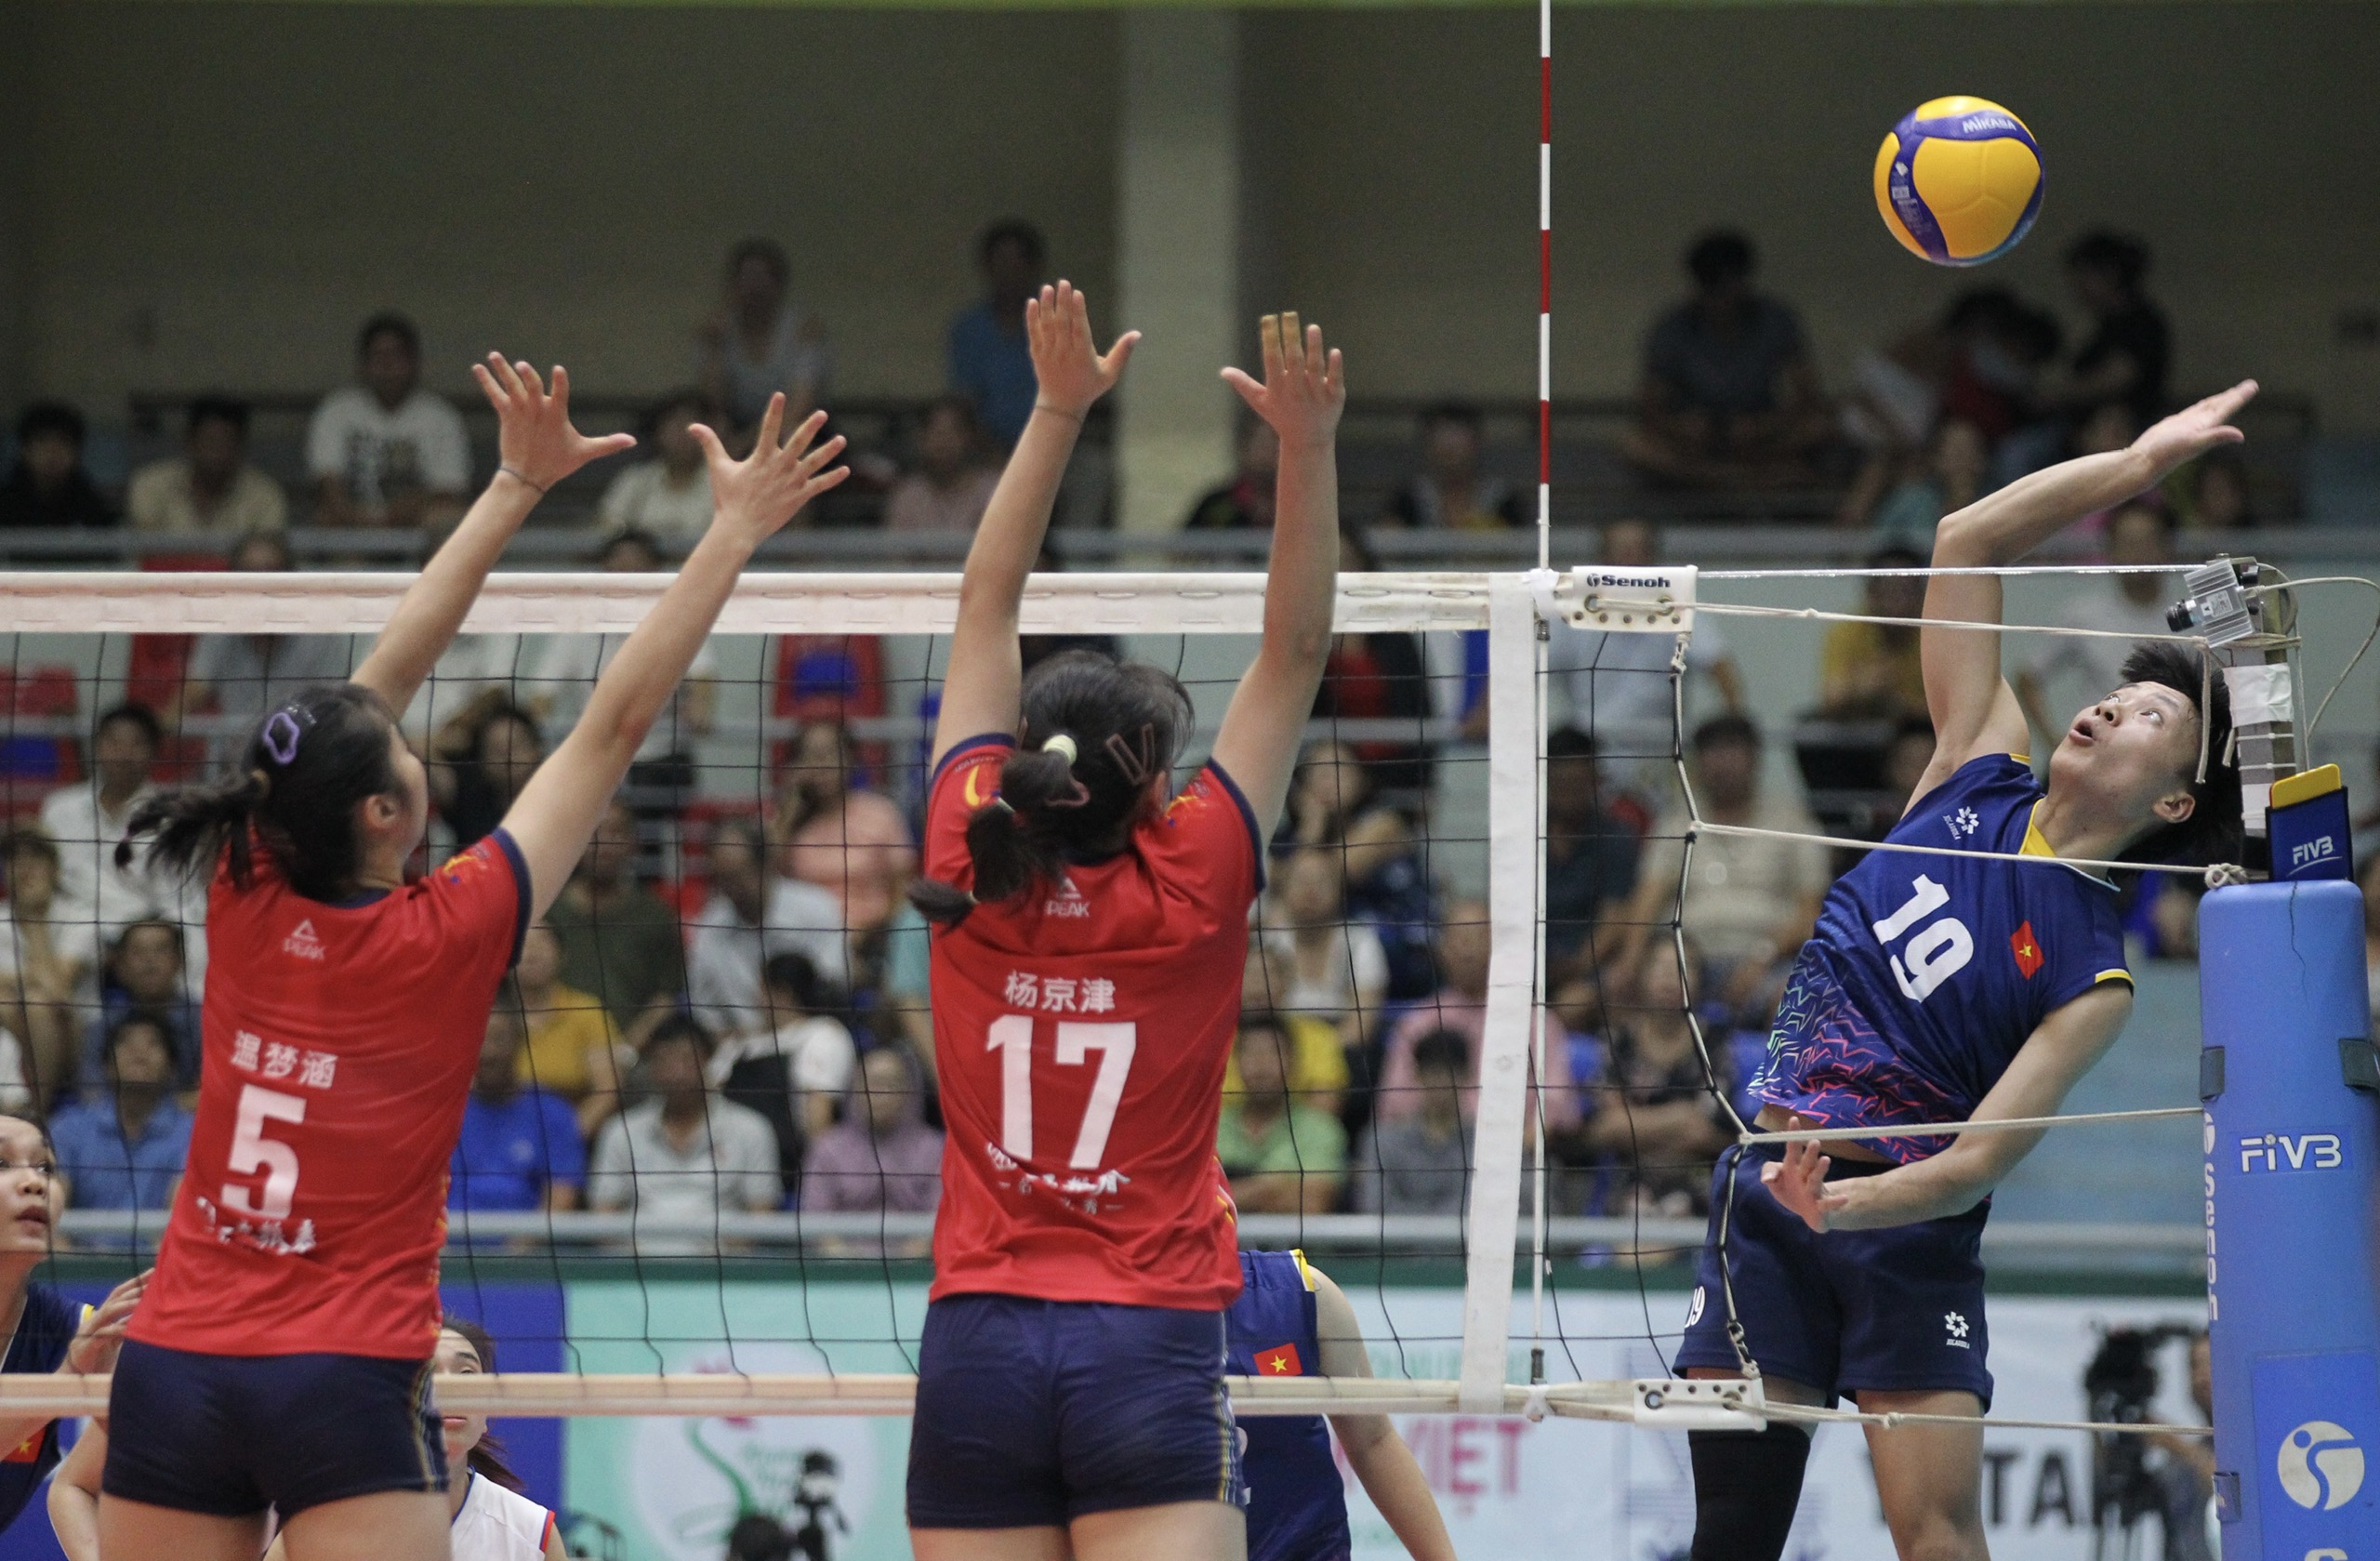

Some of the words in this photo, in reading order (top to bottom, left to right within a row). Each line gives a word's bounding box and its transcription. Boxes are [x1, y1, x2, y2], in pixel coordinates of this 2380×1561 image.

[1601, 575, 1671, 588] Senoh
[2292, 835, 2334, 866] FIVB
[1045, 899, 1090, 918] PEAK
[1872, 873, 1975, 1004] 19
[1005, 970, 1116, 1013] 杨京津
[230, 1029, 338, 1091] 温梦涵
[985, 1014, 1137, 1171] 17
[219, 1082, 308, 1221] 5
